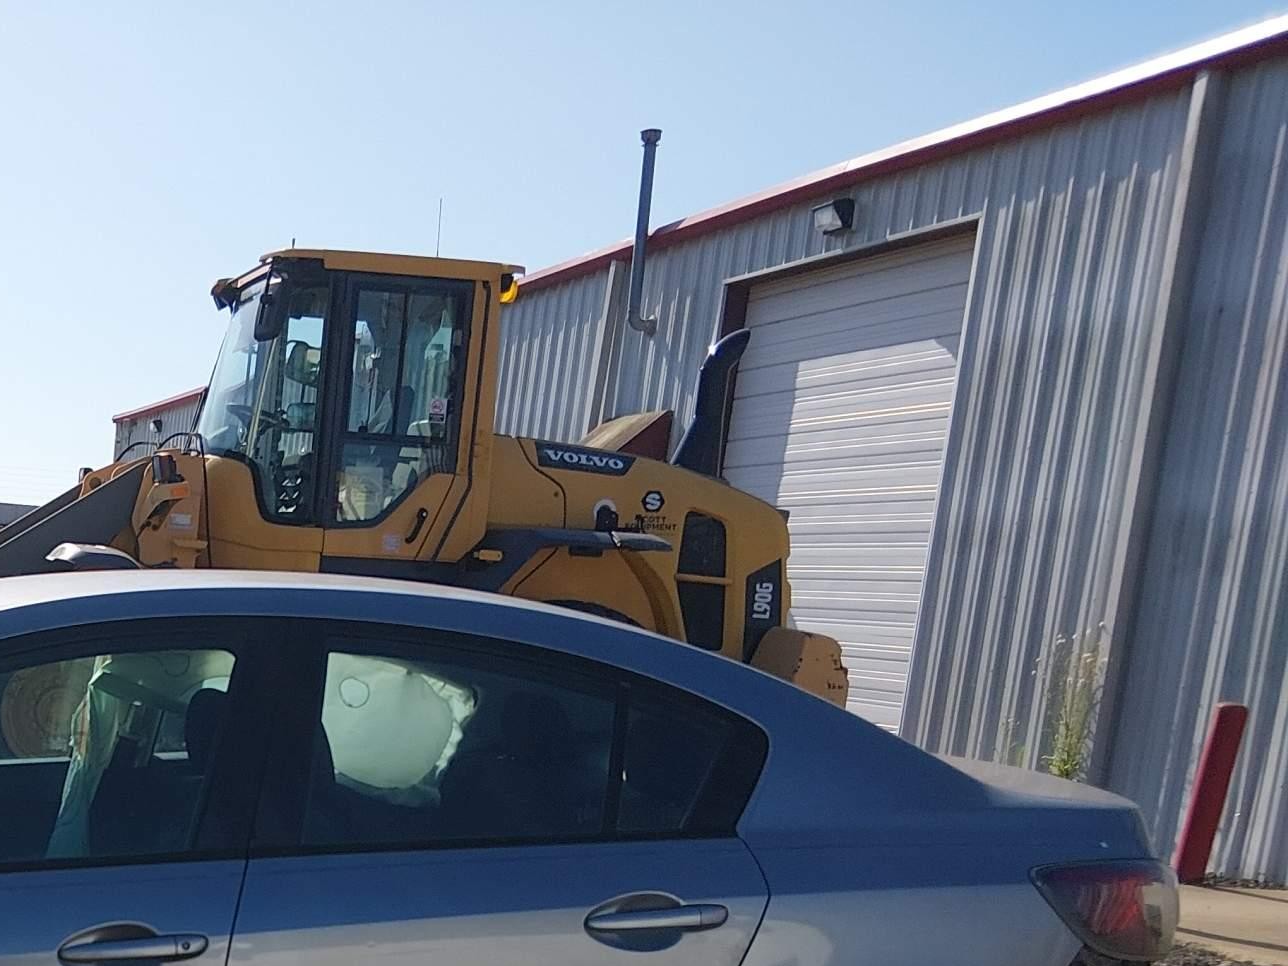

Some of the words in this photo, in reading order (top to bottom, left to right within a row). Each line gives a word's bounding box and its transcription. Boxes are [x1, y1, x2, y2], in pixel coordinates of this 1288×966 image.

[544, 449, 624, 469] VOLVO
[624, 522, 677, 531] EQUPMENT
[635, 514, 667, 524] COTT
[752, 582, 774, 619] L90G
